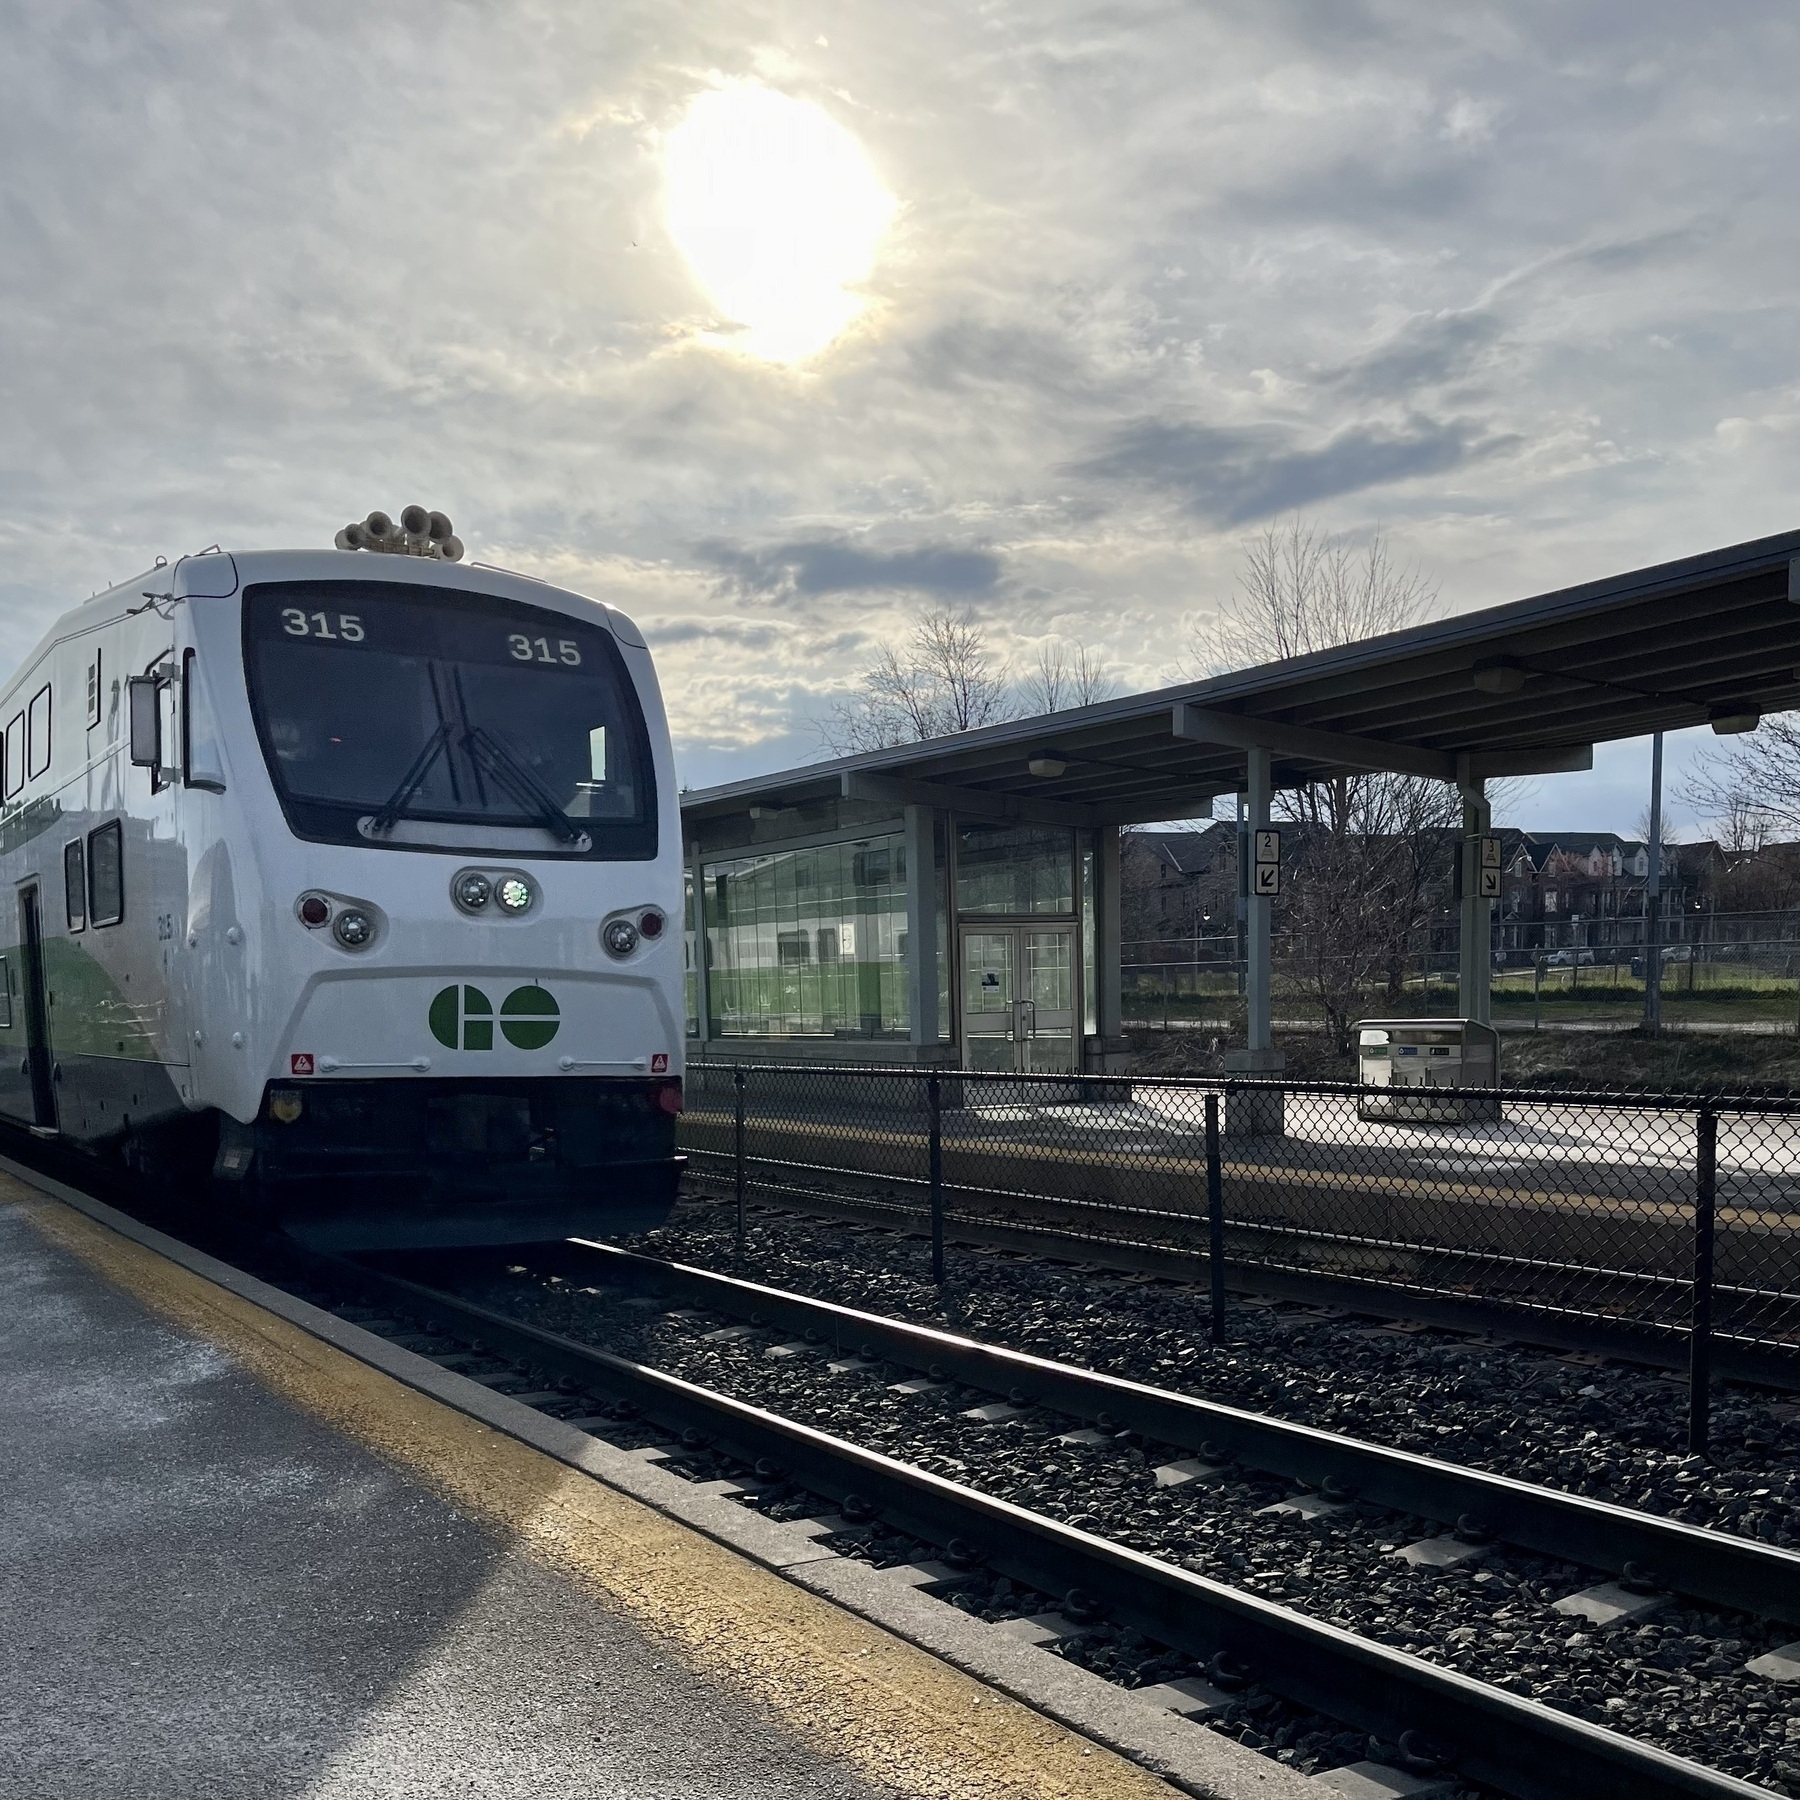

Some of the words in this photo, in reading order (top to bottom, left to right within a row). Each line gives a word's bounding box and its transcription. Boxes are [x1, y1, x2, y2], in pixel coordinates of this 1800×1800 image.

[281, 608, 365, 642] 315
[508, 634, 582, 665] 315
[1264, 835, 1272, 848] 2
[1489, 840, 1495, 853] 3
[428, 984, 561, 1051] GO
